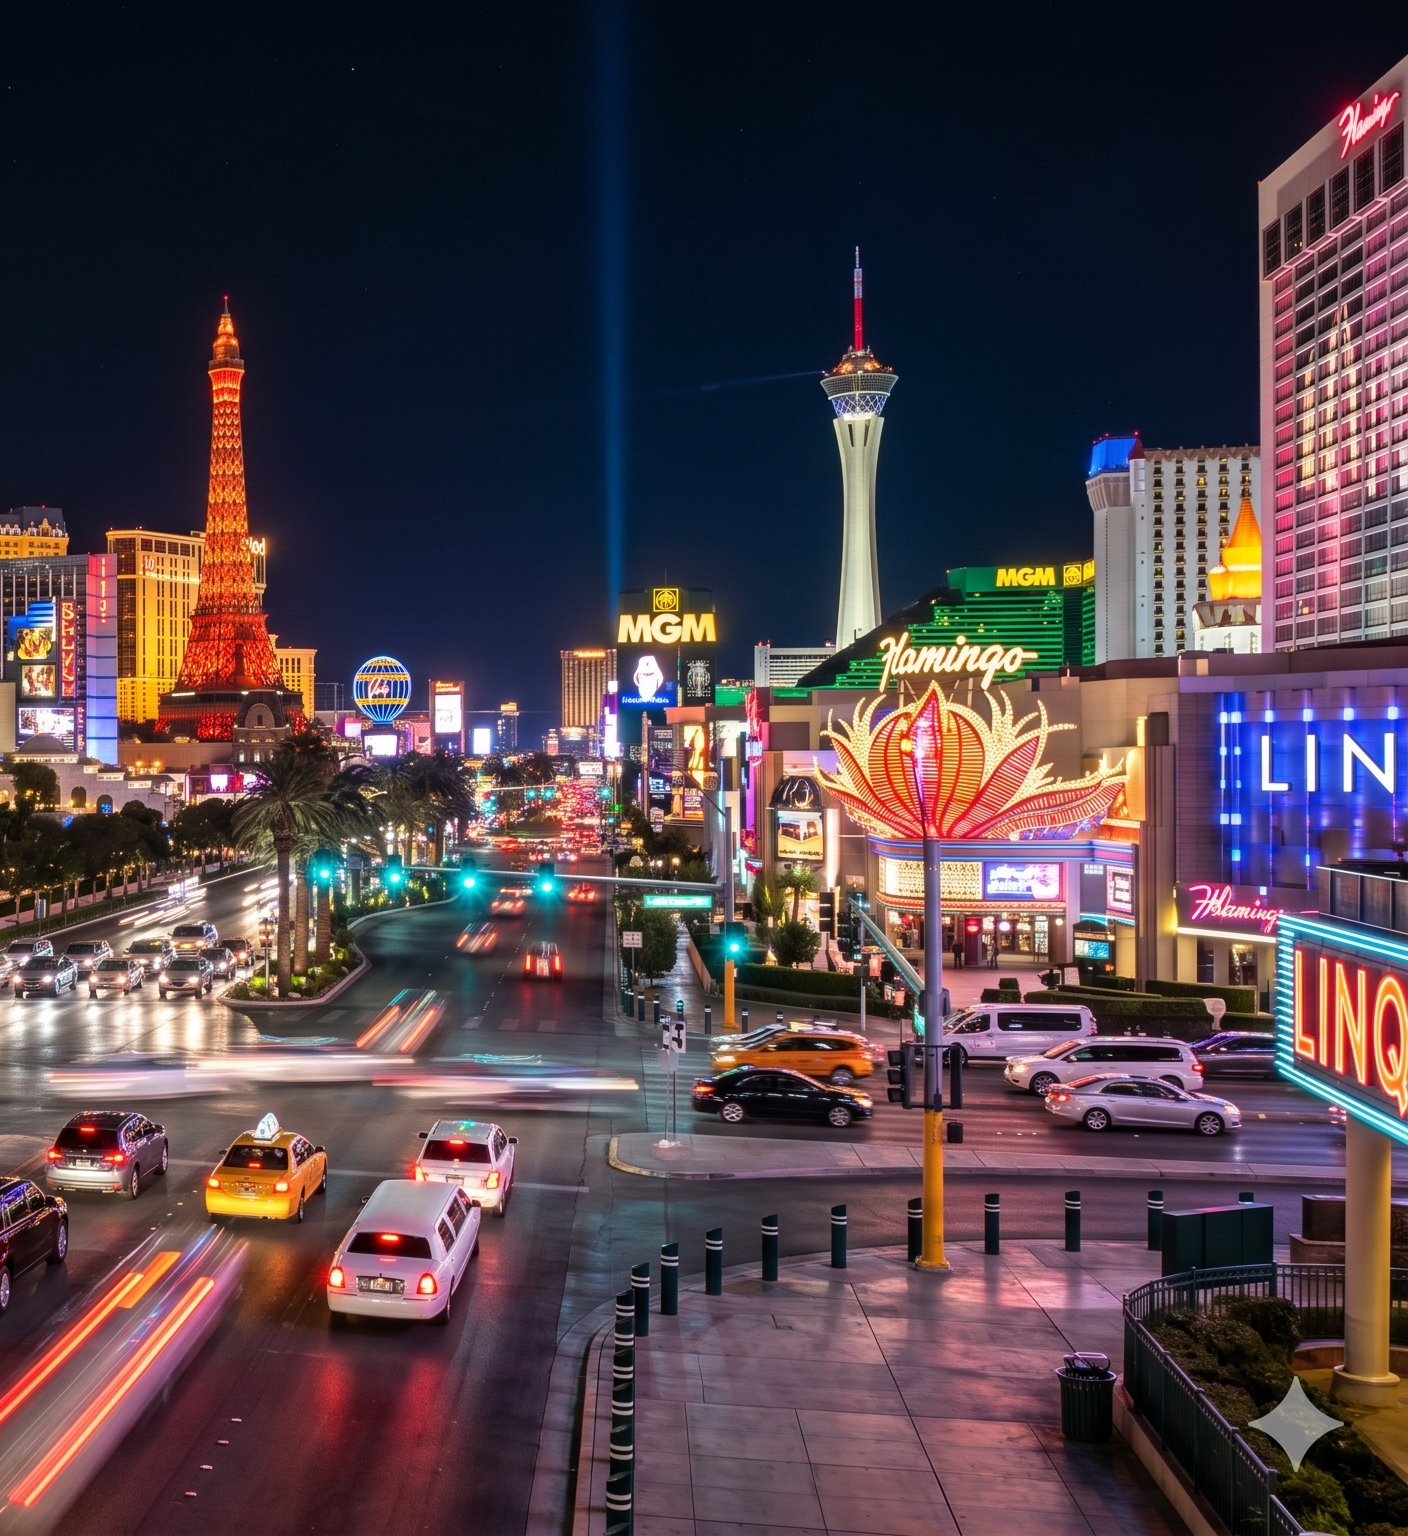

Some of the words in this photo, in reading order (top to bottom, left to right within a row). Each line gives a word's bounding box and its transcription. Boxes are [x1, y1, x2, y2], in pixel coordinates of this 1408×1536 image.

[995, 566, 1056, 588] MGM
[617, 612, 717, 644] MGM
[879, 632, 1038, 693] Flamingo
[1261, 732, 1398, 794] LIN
[1294, 948, 1408, 1118] LINQ
